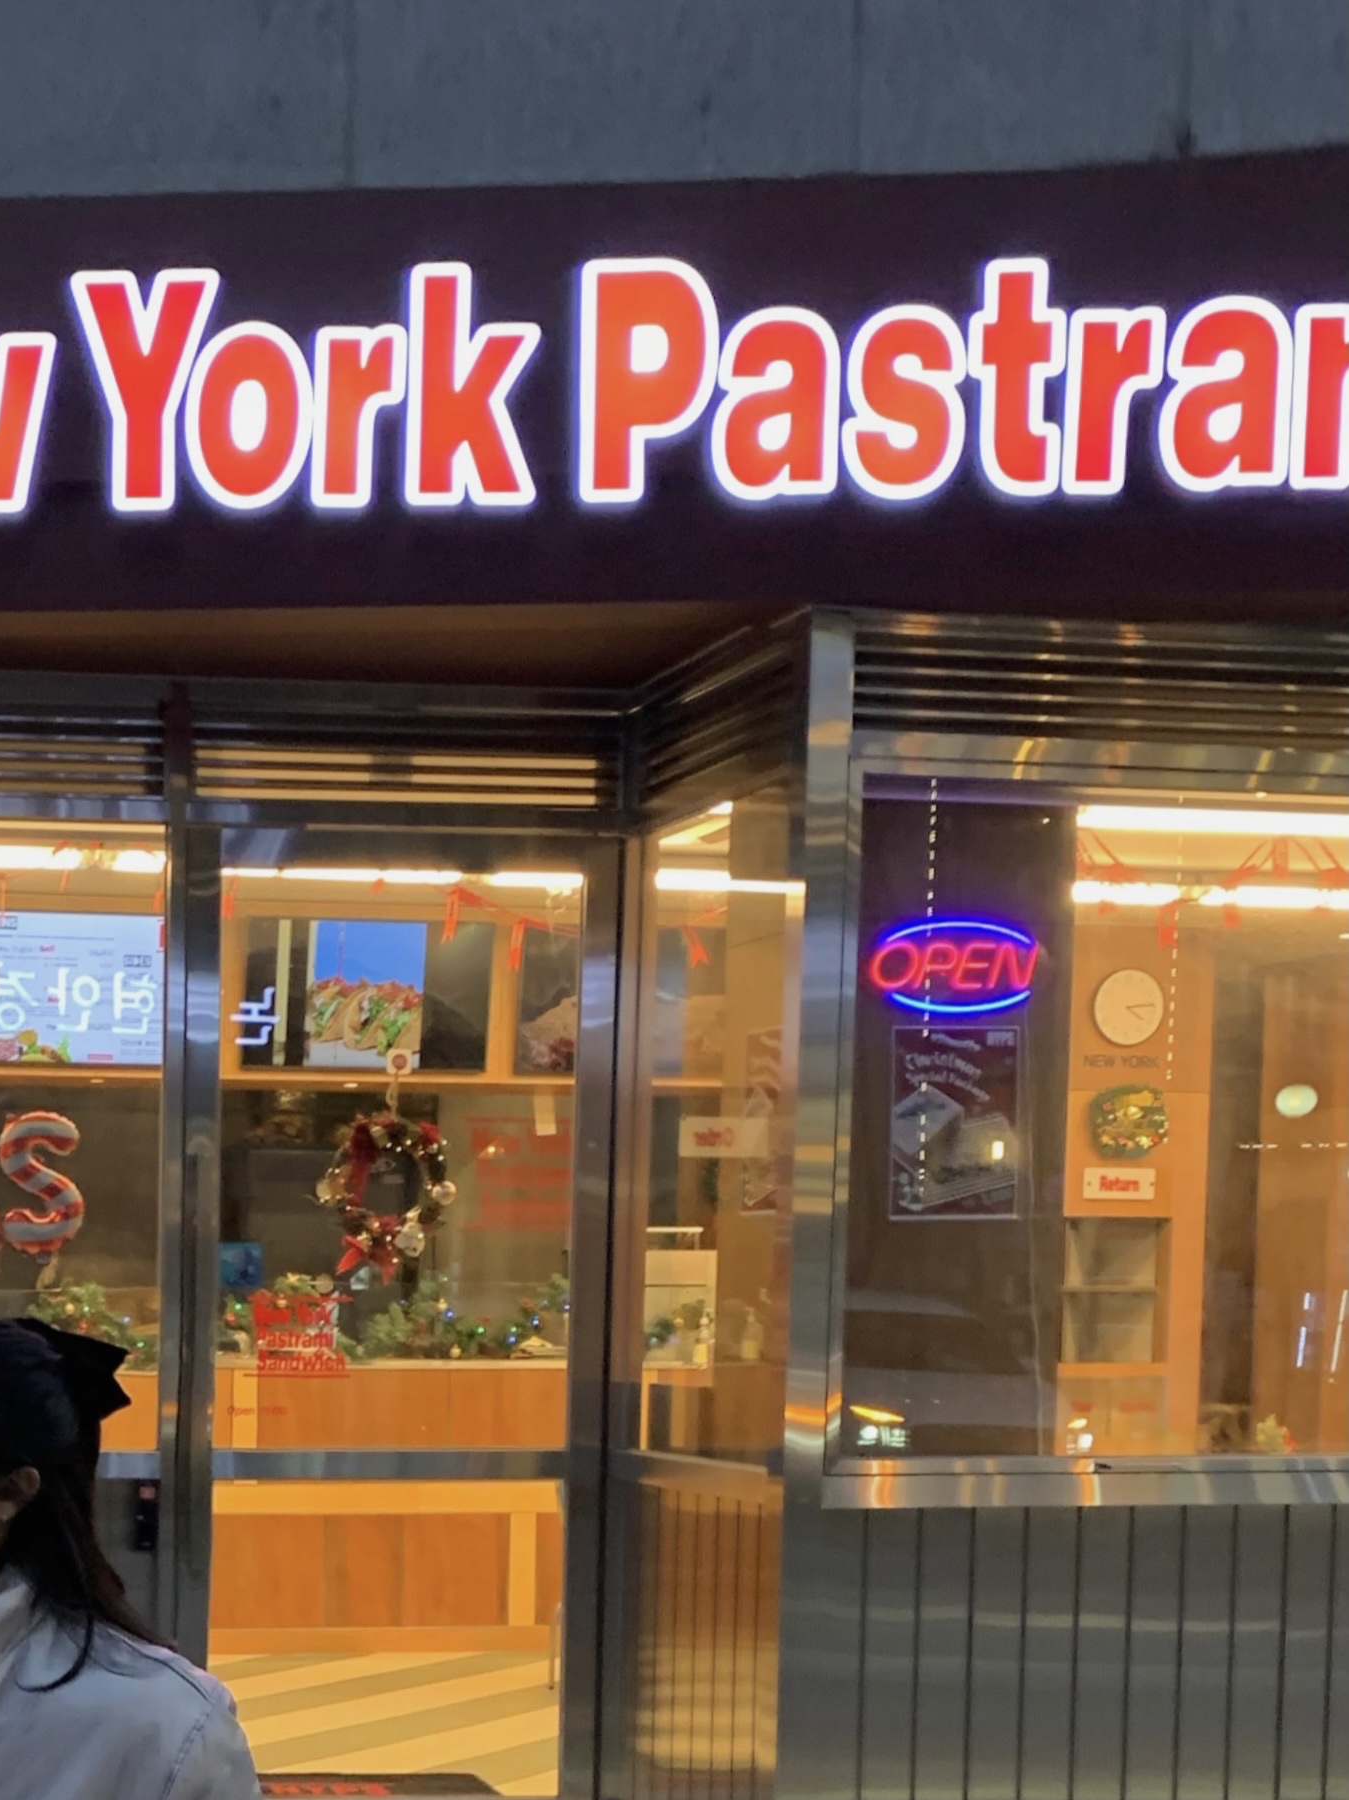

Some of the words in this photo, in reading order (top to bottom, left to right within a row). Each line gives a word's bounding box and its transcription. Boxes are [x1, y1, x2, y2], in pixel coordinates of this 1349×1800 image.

[70, 261, 542, 512] York
[869, 940, 1040, 991] OPEN
[1083, 1054, 1115, 1068] NEW
[1121, 1055, 1160, 1069] YORK
[1099, 1175, 1140, 1192] Return
[256, 1327, 335, 1348] Pastrami
[257, 1348, 347, 1371] Sandwich
